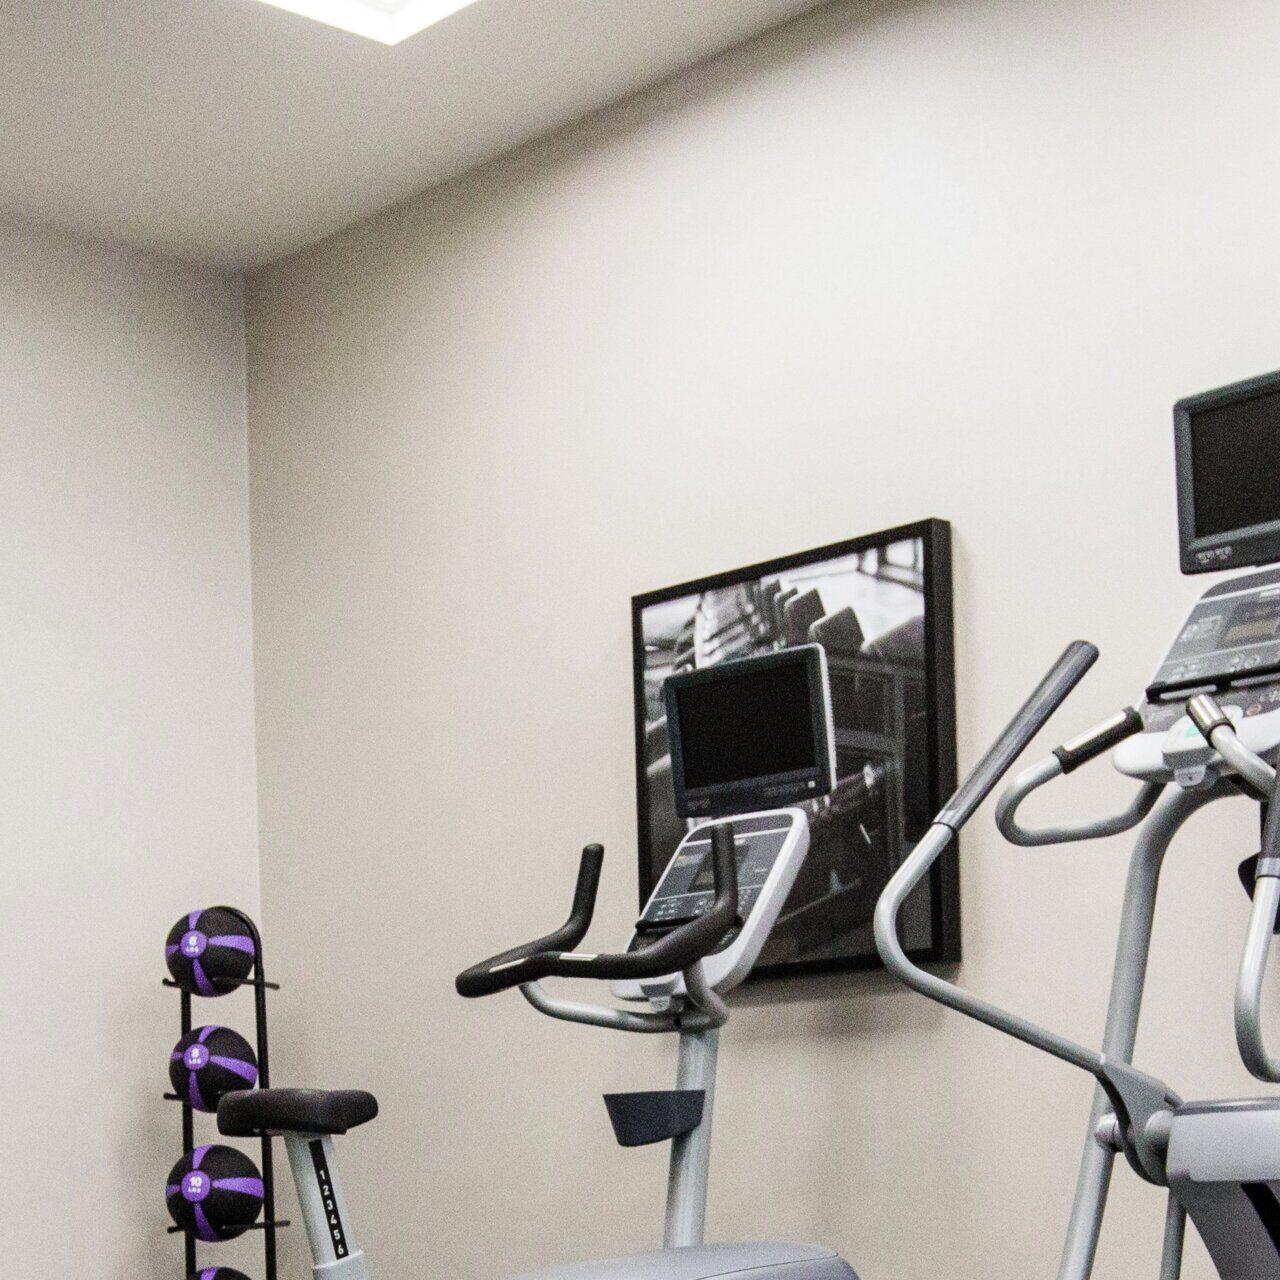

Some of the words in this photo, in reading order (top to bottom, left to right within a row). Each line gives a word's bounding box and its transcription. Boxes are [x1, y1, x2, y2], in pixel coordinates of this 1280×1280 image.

[189, 1176, 203, 1187] 10
[323, 1185, 329, 1196] 2
[326, 1200, 333, 1210] 3
[330, 1215, 337, 1225] 4
[334, 1230, 341, 1240] 5
[338, 1245, 344, 1255] 6
